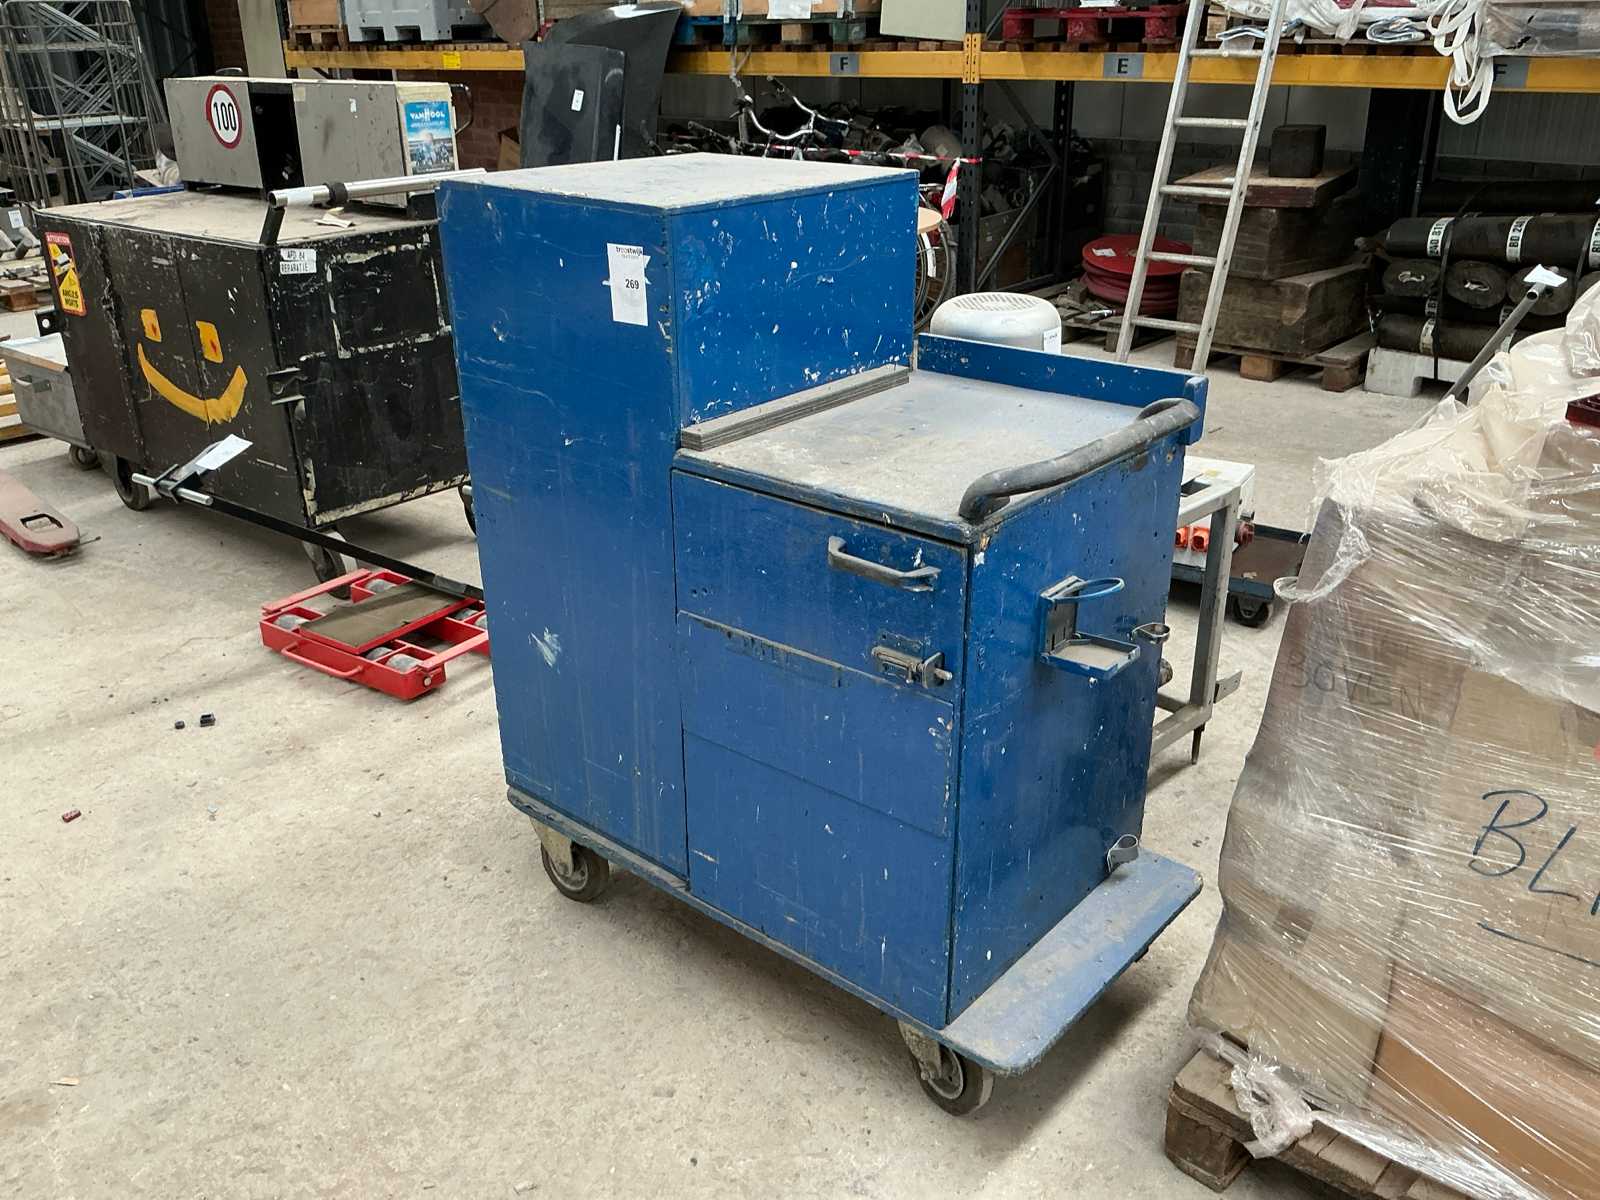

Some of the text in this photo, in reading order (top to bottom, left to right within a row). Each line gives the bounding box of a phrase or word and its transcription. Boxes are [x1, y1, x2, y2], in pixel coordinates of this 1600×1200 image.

[840, 56, 849, 71] F
[1117, 58, 1129, 73] E
[214, 102, 237, 131] 100
[625, 278, 640, 290] 269
[1467, 789, 1600, 916] BL
